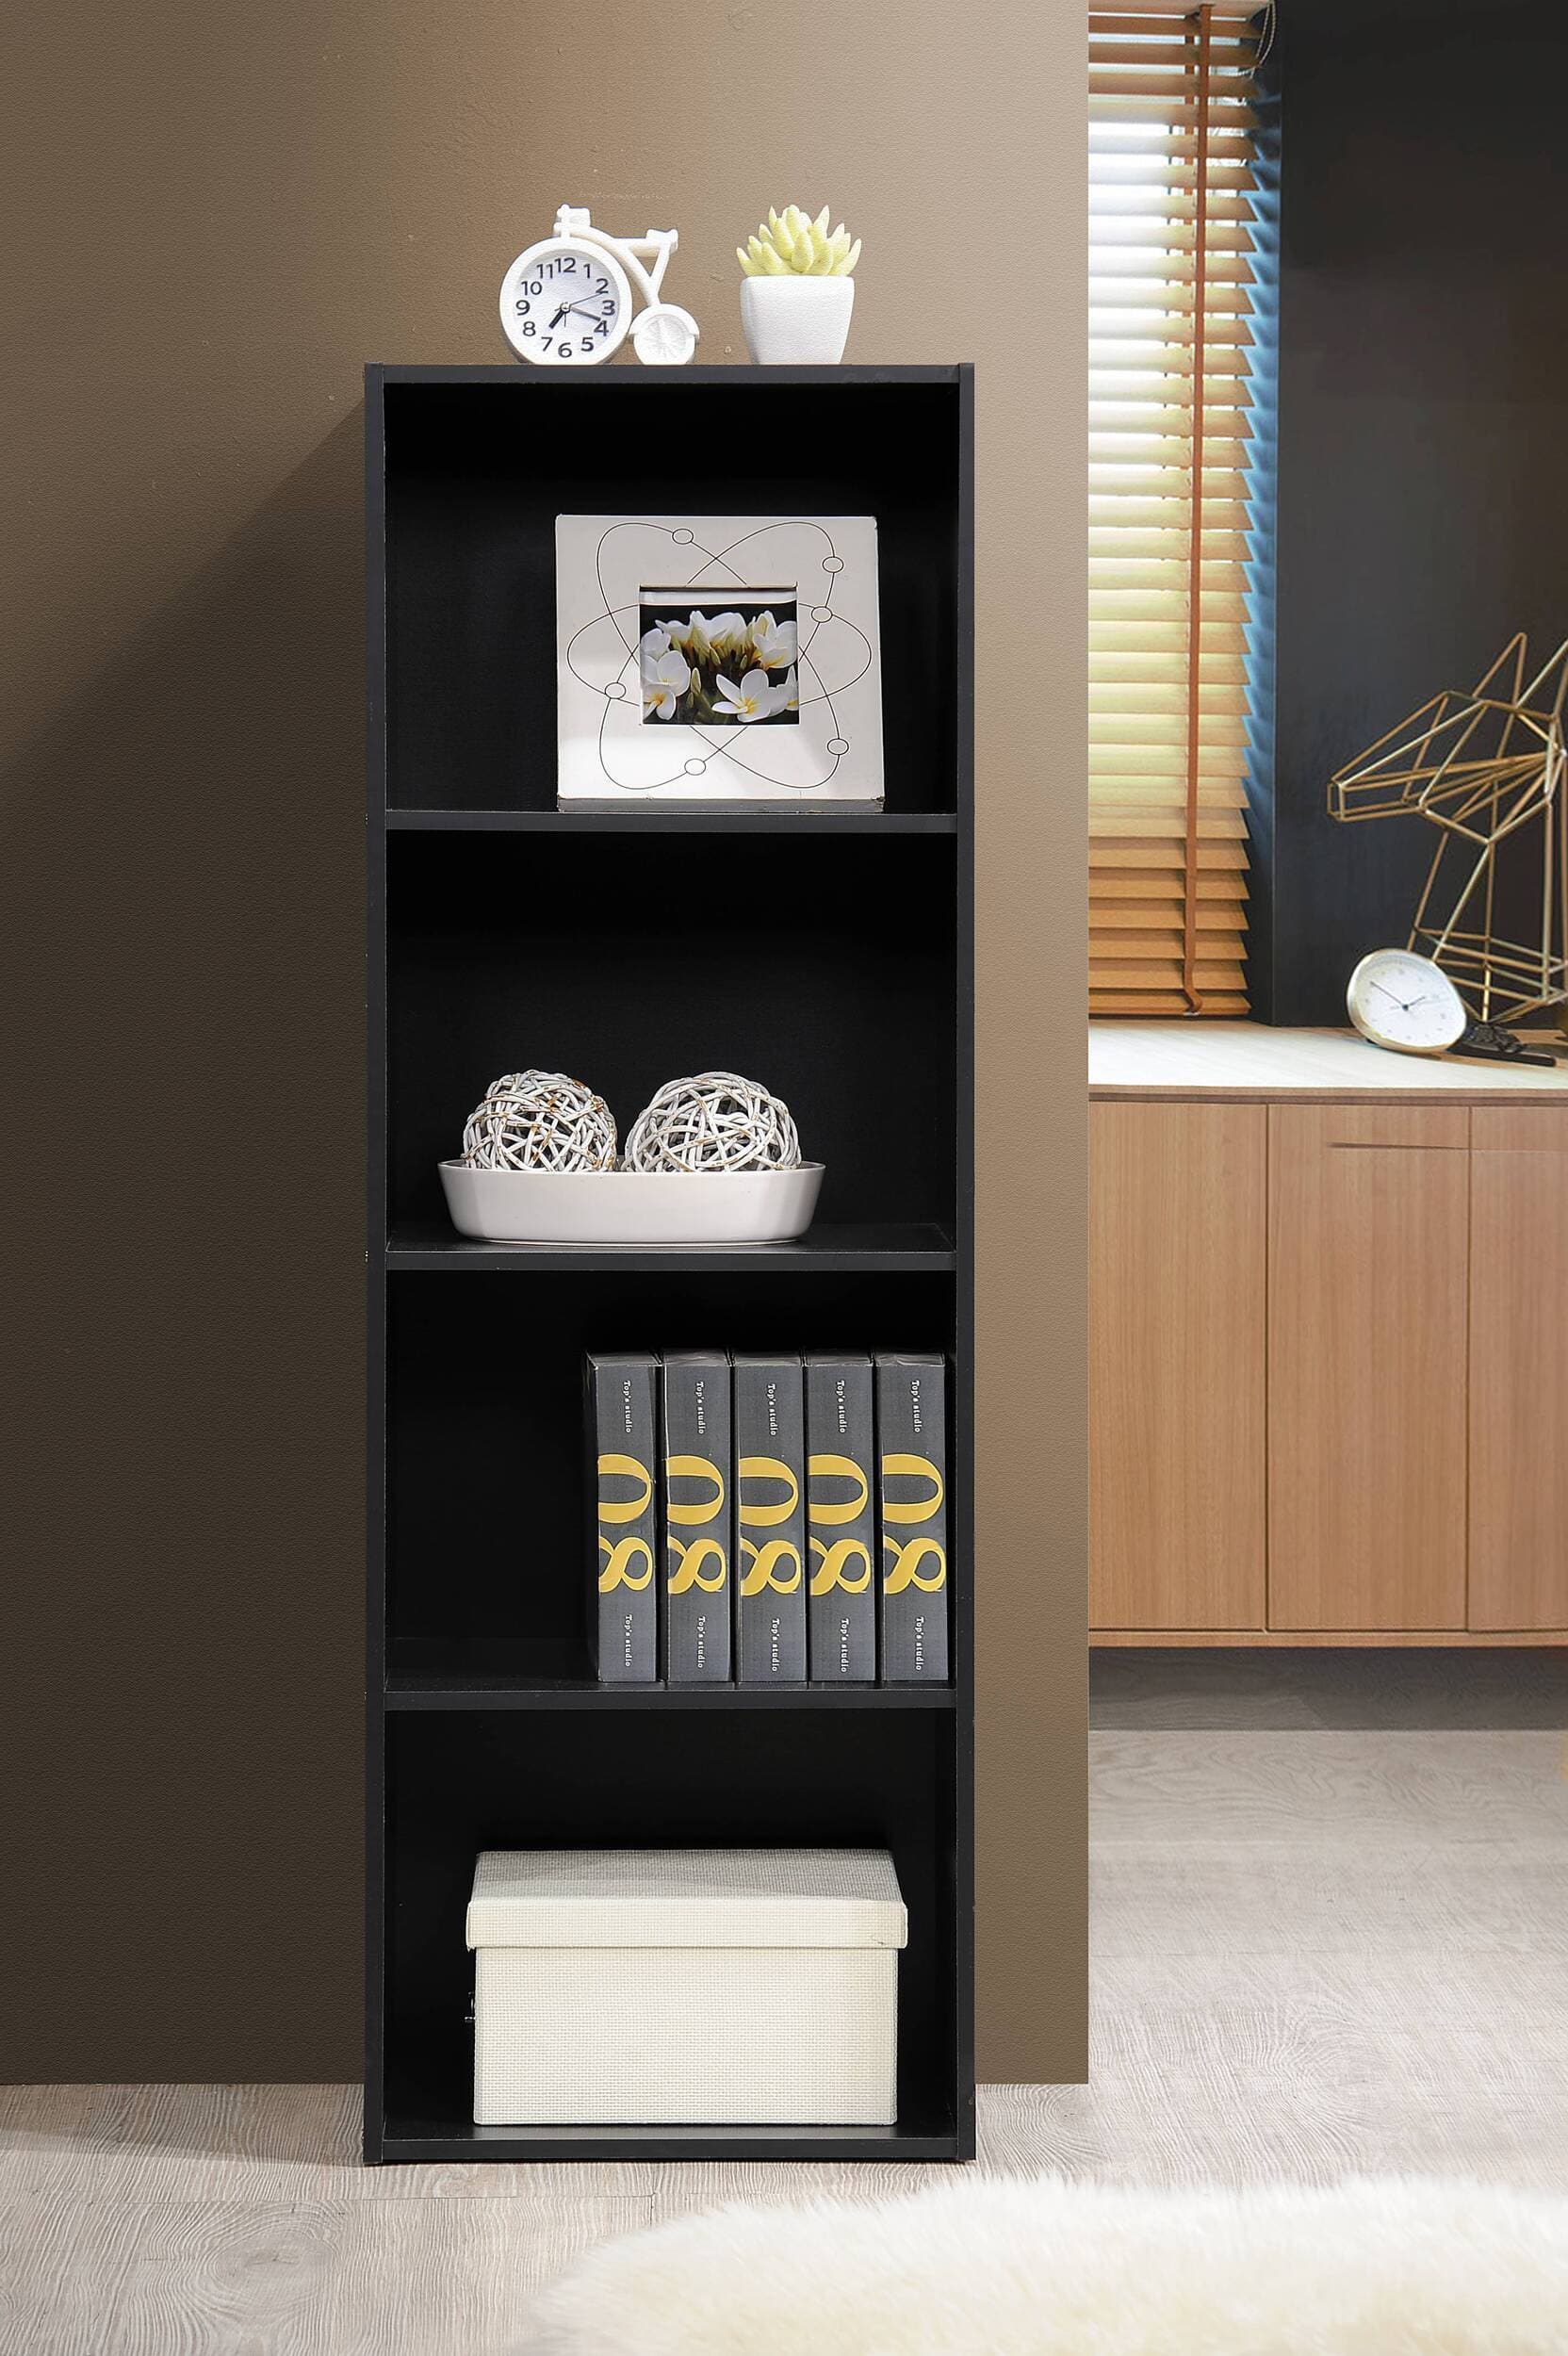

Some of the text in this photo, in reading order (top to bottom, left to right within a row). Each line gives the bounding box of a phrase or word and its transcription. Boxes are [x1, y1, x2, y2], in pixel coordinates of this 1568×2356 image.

[536, 264, 553, 279] 11
[555, 257, 577, 273] 12
[583, 264, 591, 279] 1
[521, 281, 543, 296] 10
[596, 278, 609, 294] 2
[515, 300, 531, 316] 9
[601, 300, 615, 316] 3
[522, 321, 536, 337] 8
[593, 320, 610, 336] 4
[541, 336, 553, 352] 7
[558, 342, 572, 358] 6
[580, 336, 595, 352] 5
[623, 1380, 633, 1433] Top's studio
[695, 1381, 706, 1434] Top's studio
[767, 1383, 778, 1436] Top's studio
[837, 1380, 848, 1433] Top's studio
[910, 1380, 923, 1432] Top's studio
[625, 1613, 633, 1667] Top's studio
[696, 1615, 706, 1669] Top's studio
[770, 1617, 780, 1672] Top's studio
[840, 1617, 850, 1673] Top's studio
[915, 1616, 924, 1671] Top's studio
